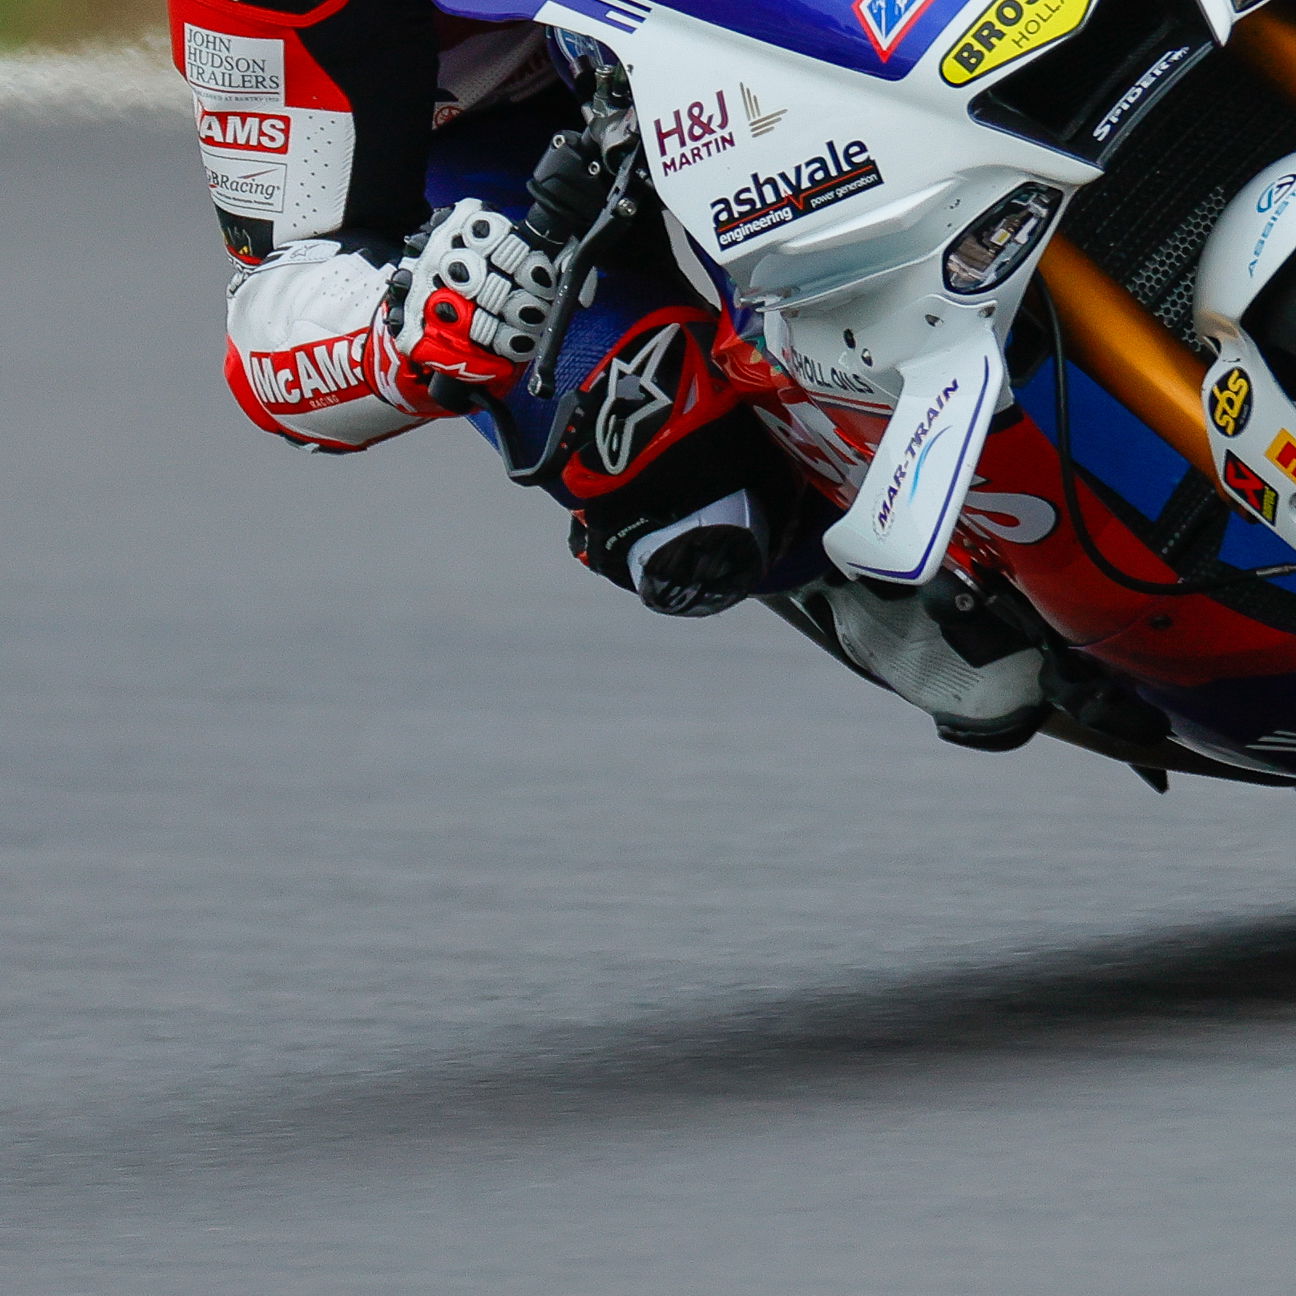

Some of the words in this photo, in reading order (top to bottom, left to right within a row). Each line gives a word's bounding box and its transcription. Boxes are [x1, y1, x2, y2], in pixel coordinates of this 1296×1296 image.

[187, 28, 232, 54] JOHN
[187, 45, 266, 74] HUDSON
[187, 61, 280, 90] TRAILERS
[199, 115, 286, 149] AMS
[653, 90, 730, 158] H&J
[662, 132, 736, 177] MARTIN
[709, 139, 873, 228] ashvale
[719, 207, 793, 245] engineering
[810, 191, 835, 208] power
[834, 173, 878, 197] generation
[309, 394, 340, 409] RACING
[1213, 368, 1249, 436] sbs
[877, 378, 960, 530] MAR-TRAIN
